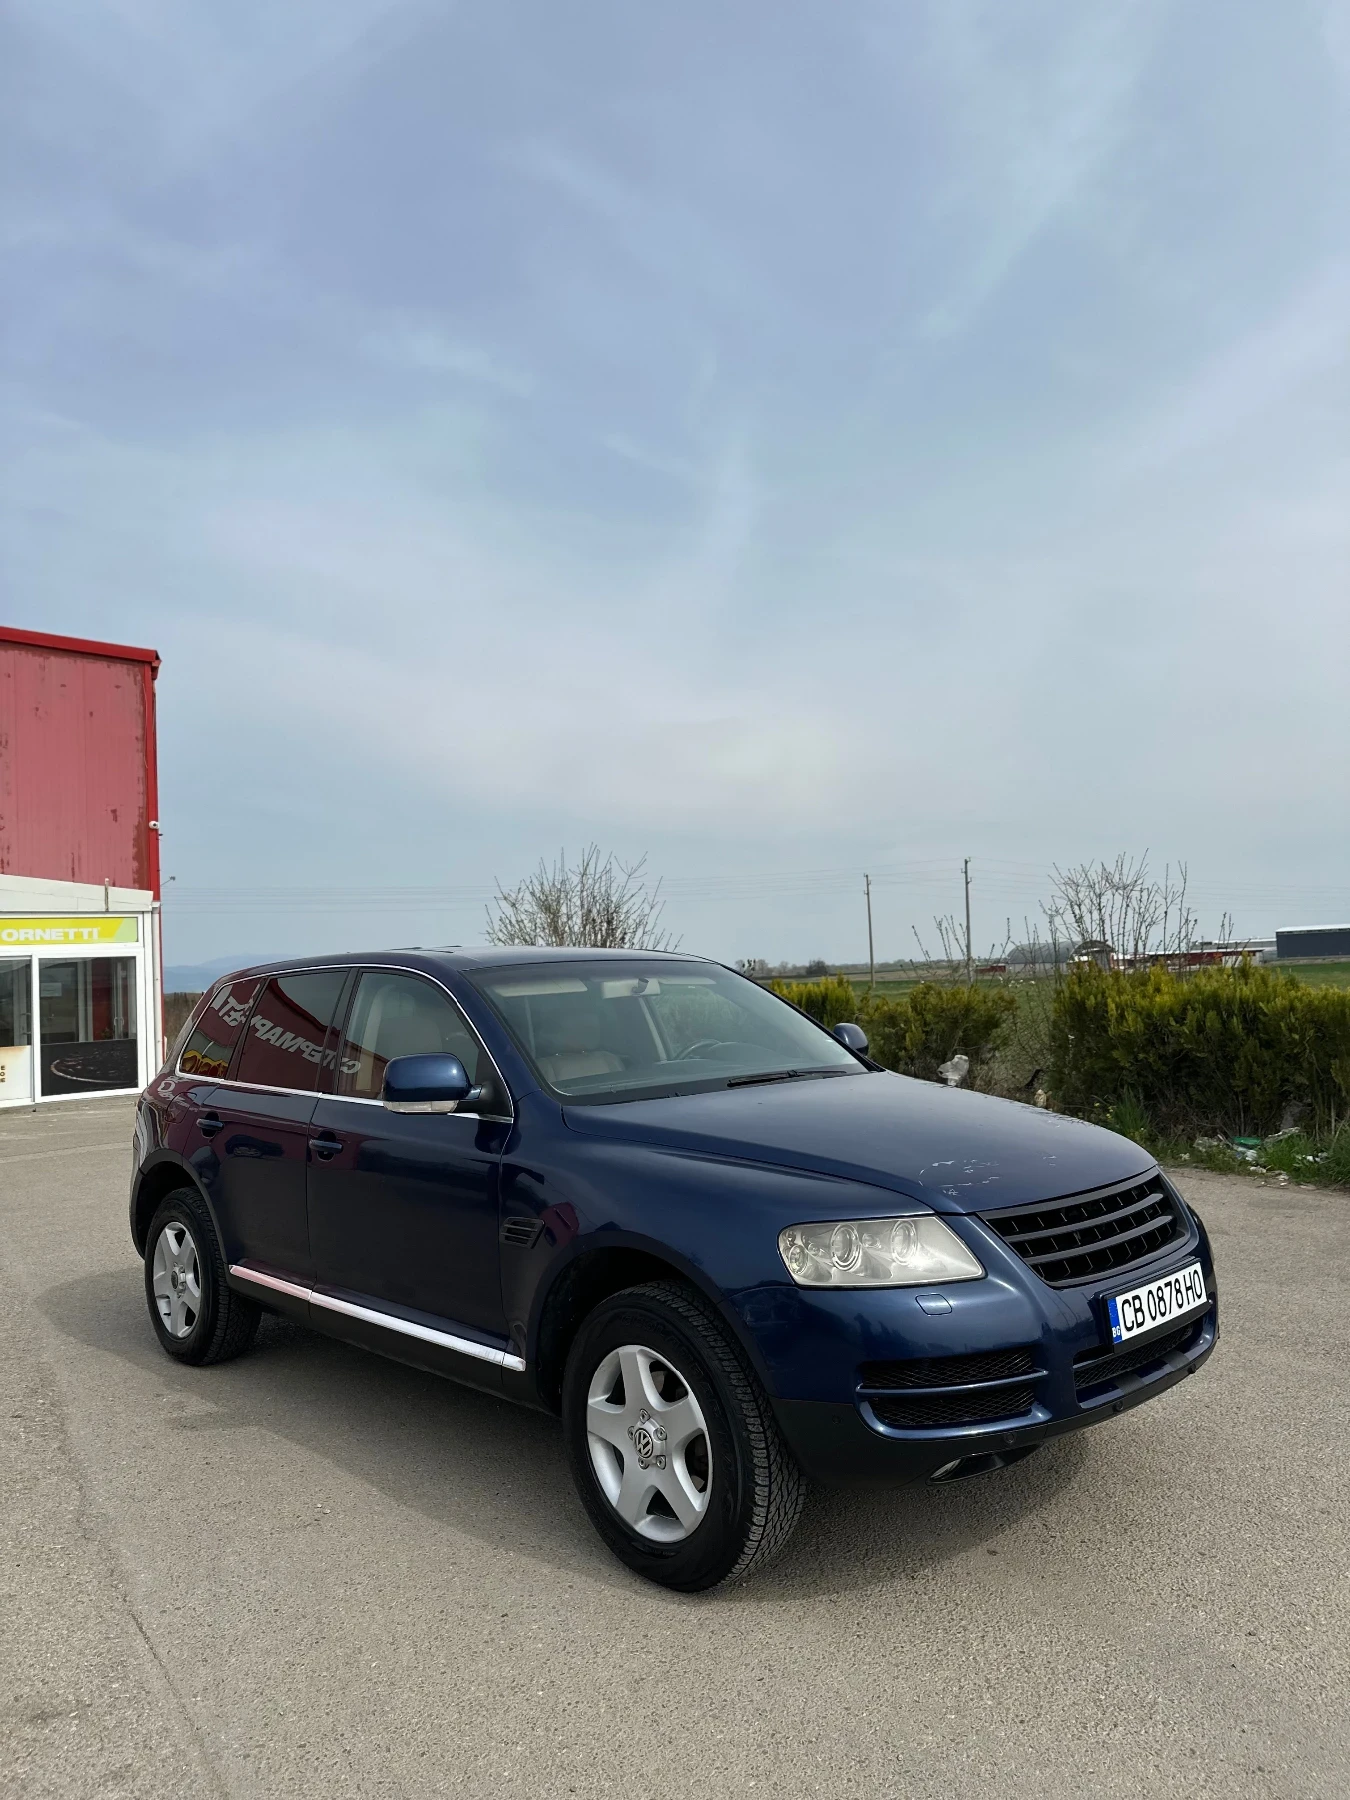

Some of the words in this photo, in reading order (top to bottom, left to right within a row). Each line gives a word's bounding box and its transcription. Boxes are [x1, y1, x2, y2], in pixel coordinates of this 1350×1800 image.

[1121, 1294, 1145, 1332] CB
[1147, 1278, 1184, 1321] 0878
[1183, 1269, 1203, 1305] HO
[1111, 1325, 1120, 1337] BG
